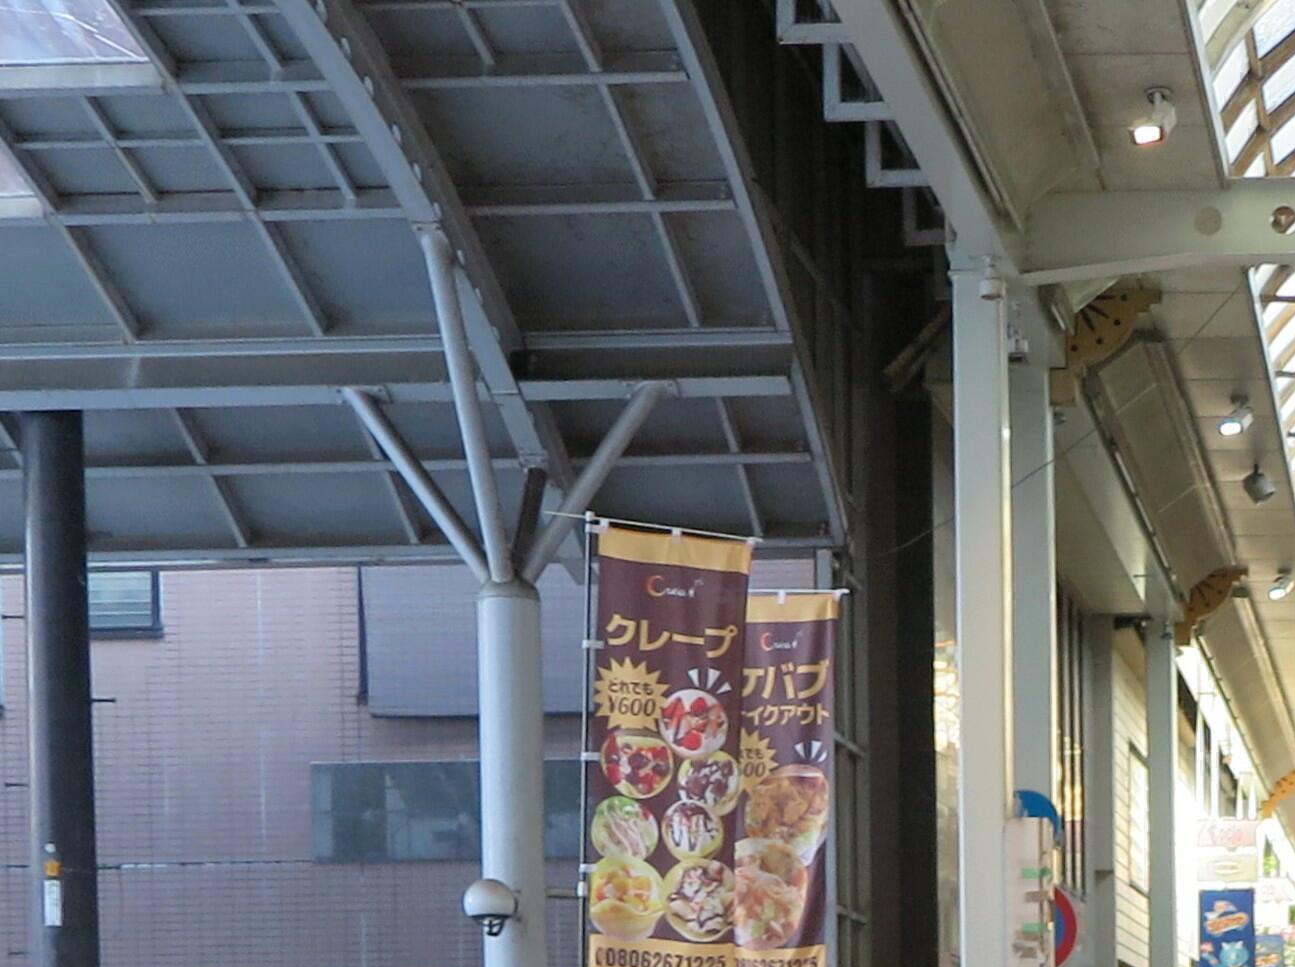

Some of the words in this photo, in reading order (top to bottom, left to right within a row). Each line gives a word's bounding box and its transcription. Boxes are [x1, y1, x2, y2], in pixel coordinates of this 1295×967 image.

[606, 613, 738, 659] クレープ
[608, 679, 655, 696] どれでも
[608, 695, 656, 717] ¥600
[740, 703, 830, 727] イクアウト
